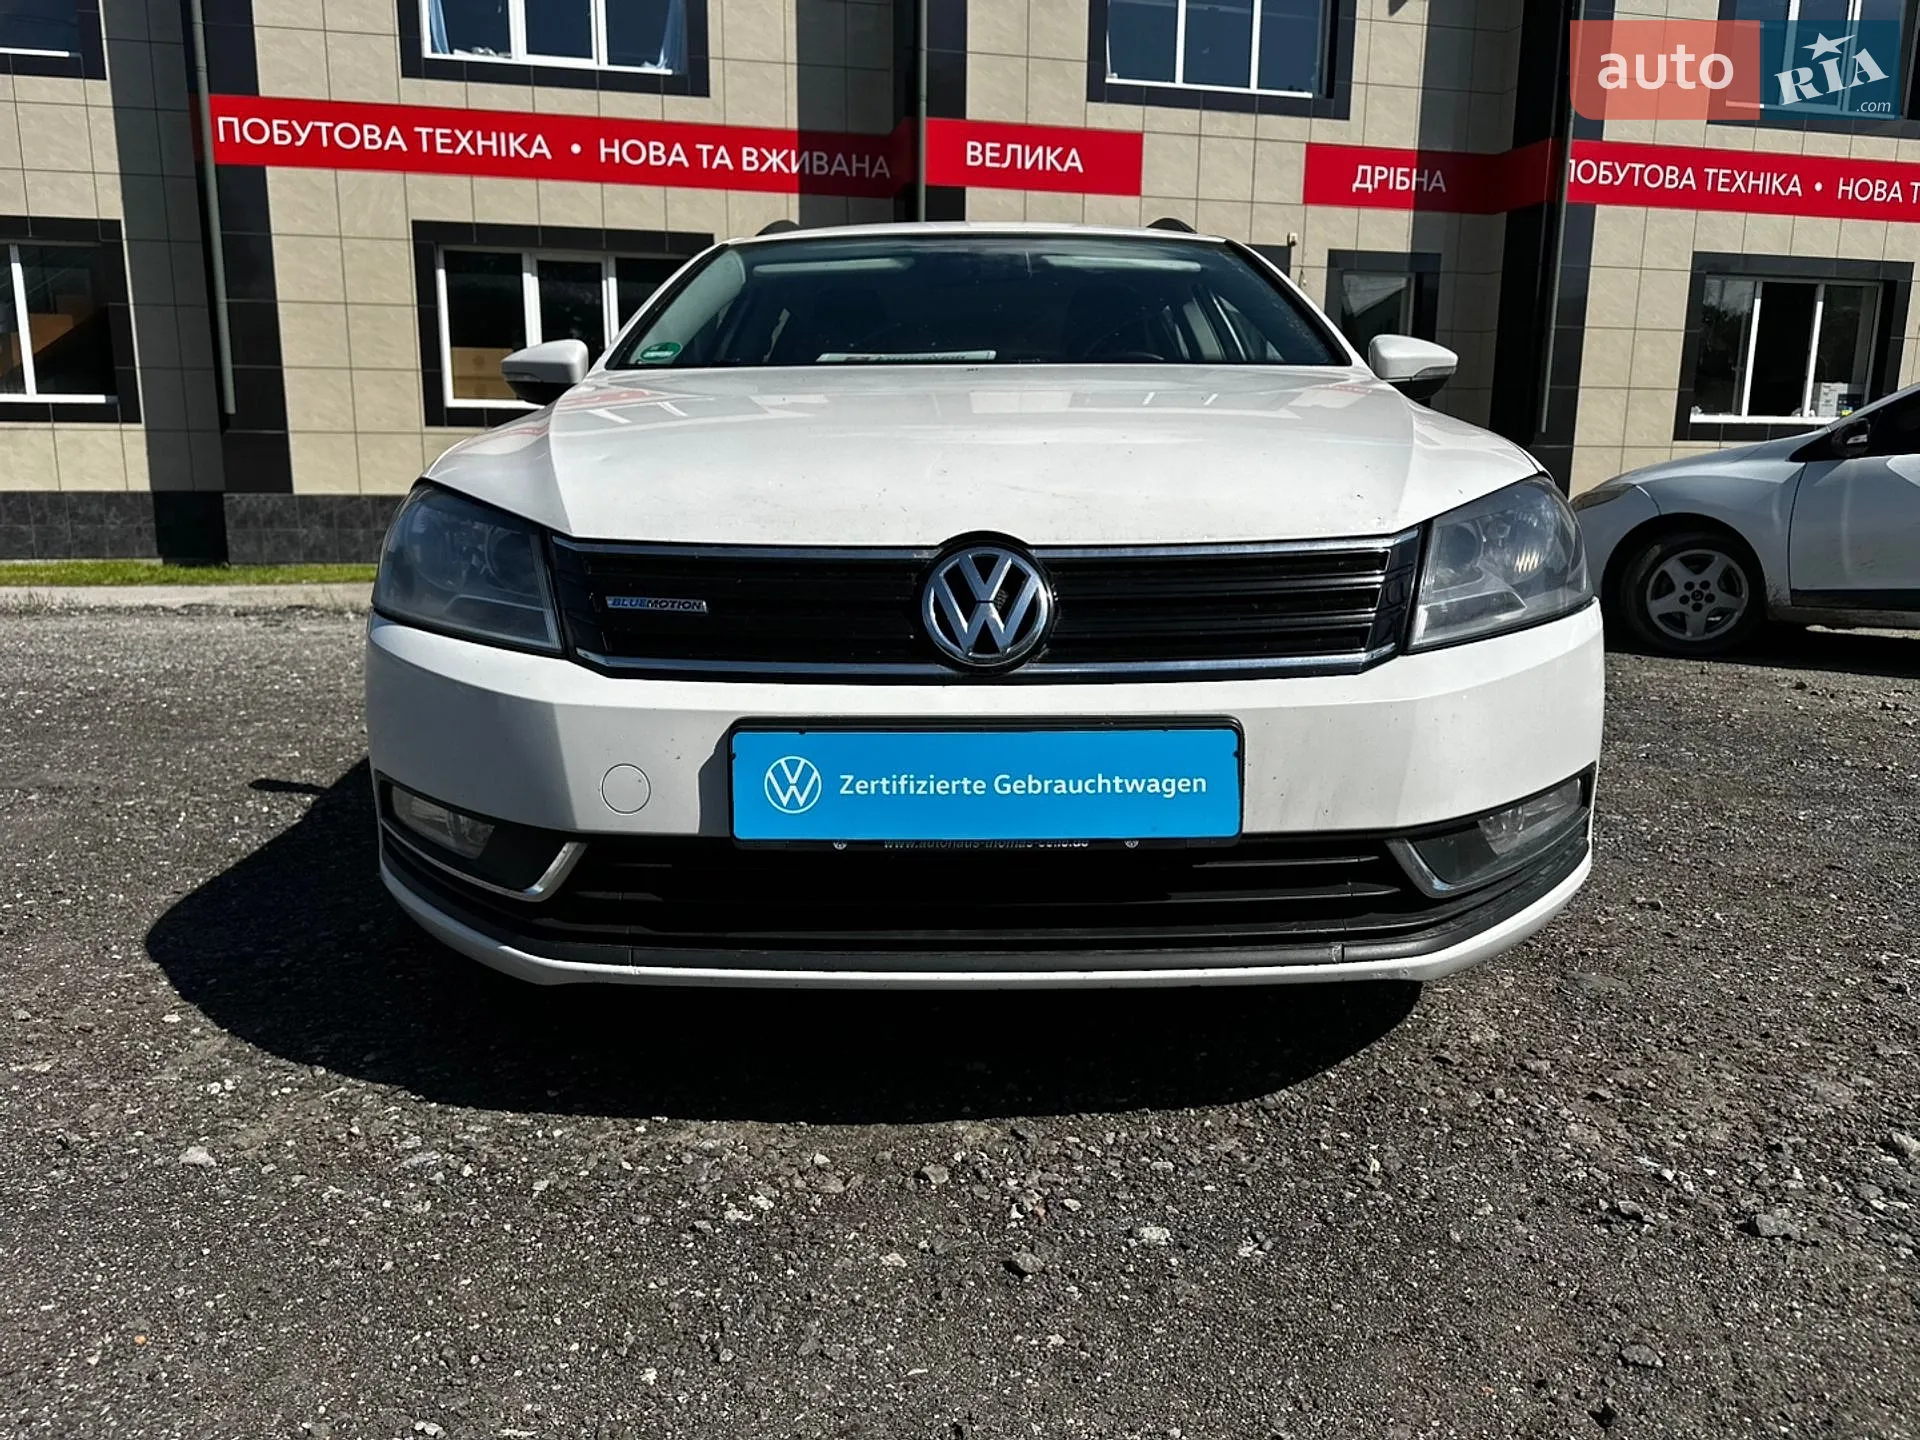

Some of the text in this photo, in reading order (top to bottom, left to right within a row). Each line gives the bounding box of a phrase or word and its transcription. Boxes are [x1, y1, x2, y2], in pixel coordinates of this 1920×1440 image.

[217, 116, 891, 179] ПОБУТОВА ТЕХНІКА НОВА ТА ВЖИВАНА
[966, 140, 1084, 173] ВЕЛИКА
[1351, 164, 1446, 194] ДРІБНА
[1703, 167, 1803, 197] ТЕХНІКА
[1837, 177, 1904, 204] НОВА
[608, 597, 704, 612] BLUEMOTION
[839, 774, 987, 795] Zertifizierte
[993, 773, 1208, 799] Gebrauchtwagen
